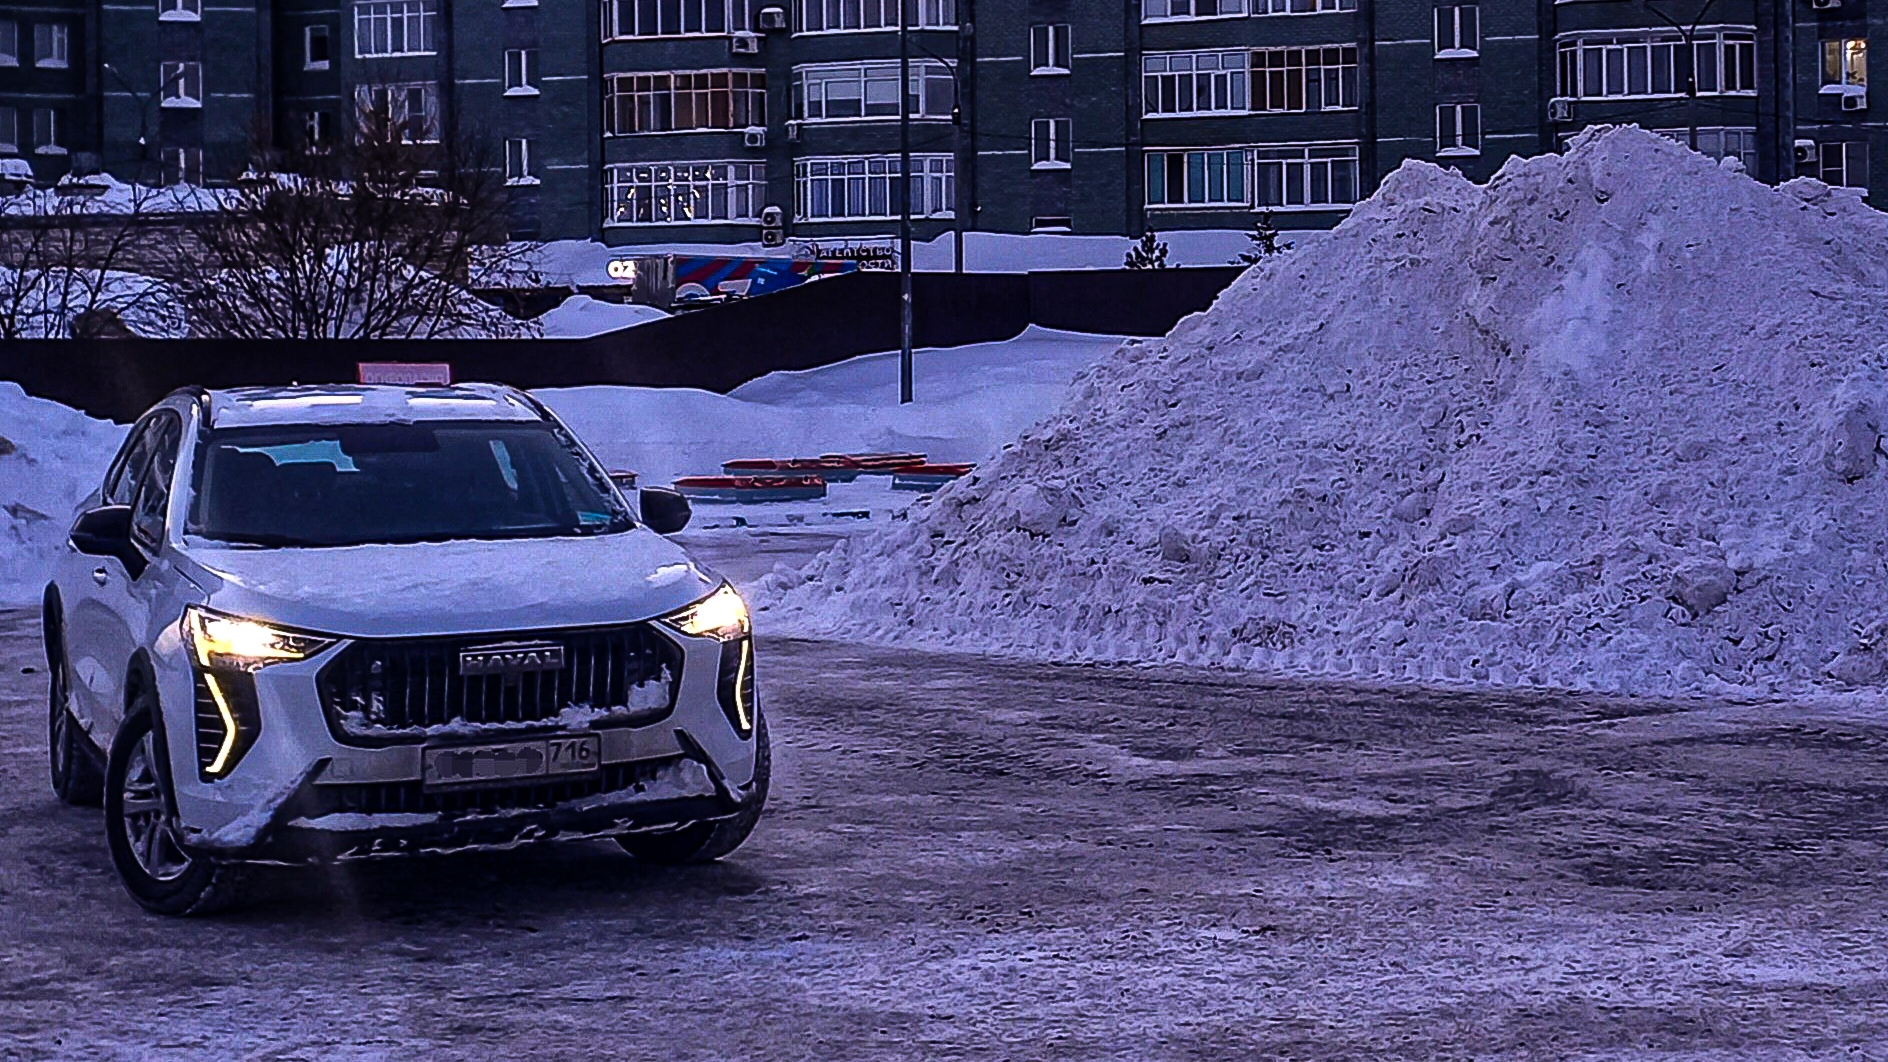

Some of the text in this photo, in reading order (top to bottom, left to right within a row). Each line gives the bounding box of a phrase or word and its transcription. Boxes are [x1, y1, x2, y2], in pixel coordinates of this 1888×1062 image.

[607, 260, 638, 278] OZ
[465, 651, 559, 668] HAVAL
[549, 739, 591, 763] 716
